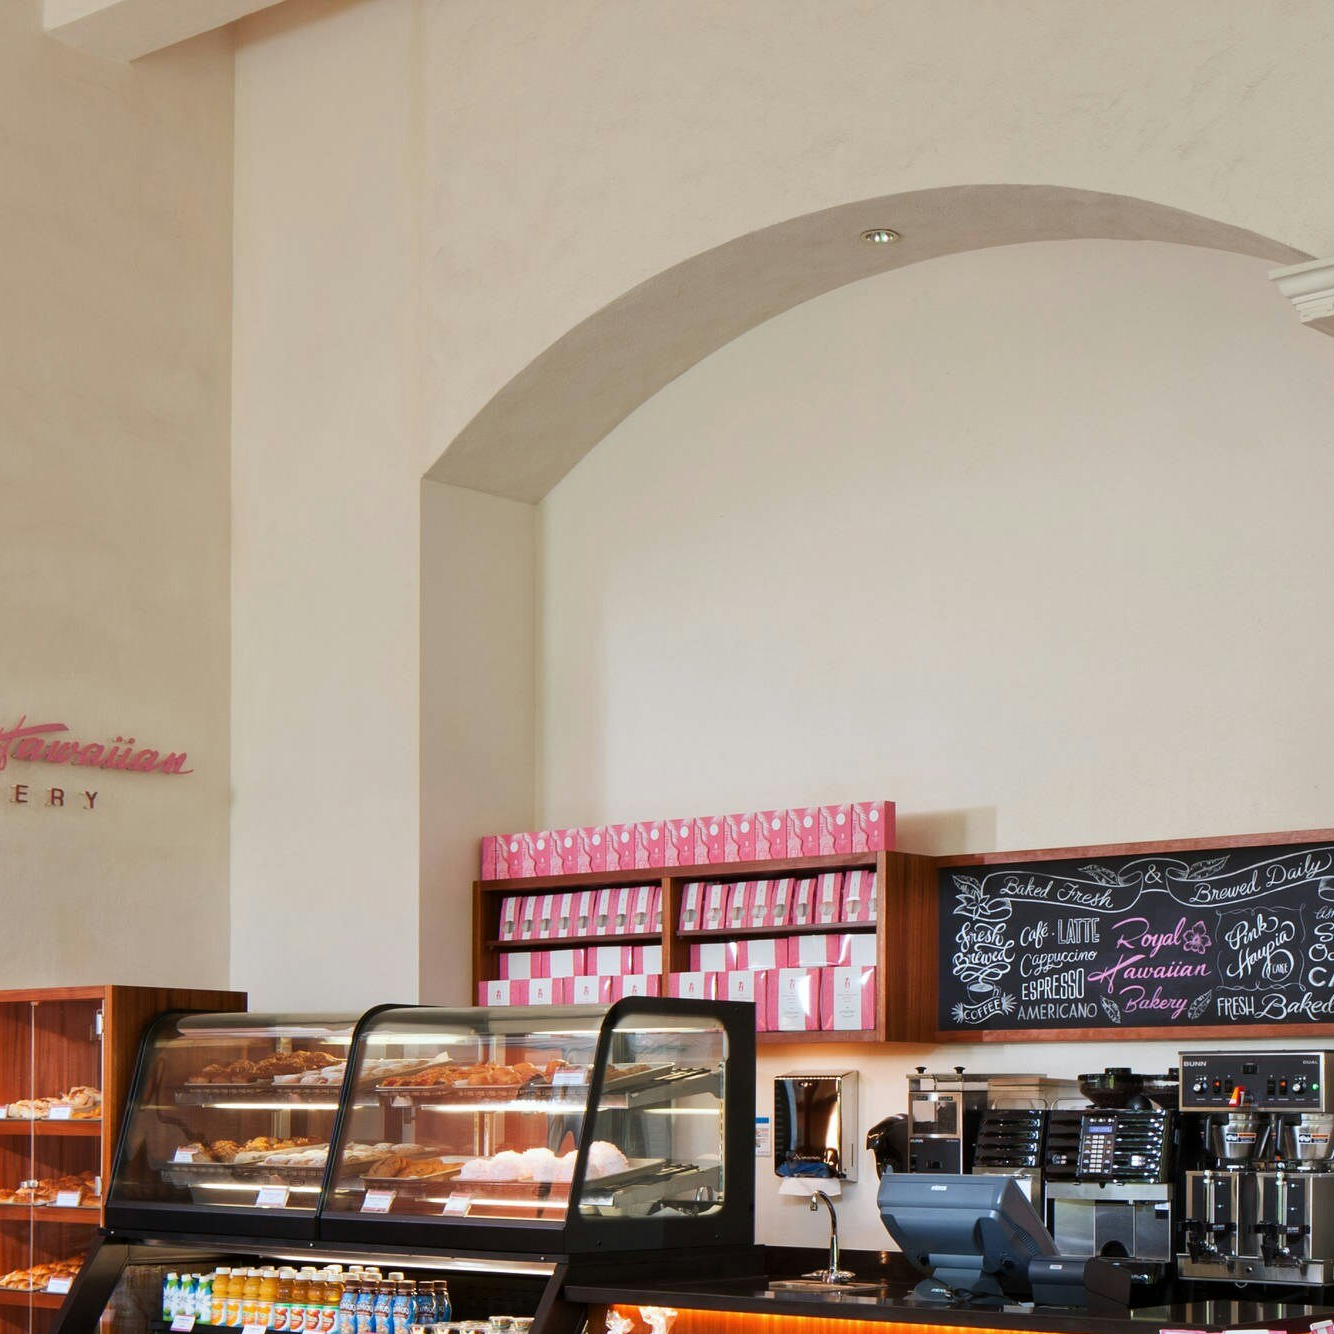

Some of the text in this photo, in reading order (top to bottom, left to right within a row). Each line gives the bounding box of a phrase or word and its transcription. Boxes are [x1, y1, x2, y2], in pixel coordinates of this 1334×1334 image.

[1000, 876, 1054, 899] Baked
[1057, 883, 1114, 908] Fresh
[1190, 870, 1261, 902] Brewed
[1266, 853, 1332, 885] Daily
[1020, 917, 1100, 949] Café LATTE
[1111, 917, 1187, 958] Royal
[1224, 913, 1279, 950] Pink
[952, 940, 1015, 968] Brewed
[1020, 949, 1098, 978] Cappuccino
[1226, 920, 1296, 982] Haupia
[1022, 968, 1085, 1001] ESPRESSO
[1087, 954, 1212, 994] Hawaiian
[1271, 962, 1289, 975] CAKE
[964, 999, 1002, 1021] COFFEE
[1017, 1003, 1098, 1021] AMERICANO
[1119, 985, 1189, 1019] Bakery
[1217, 996, 1255, 1022] FRESH
